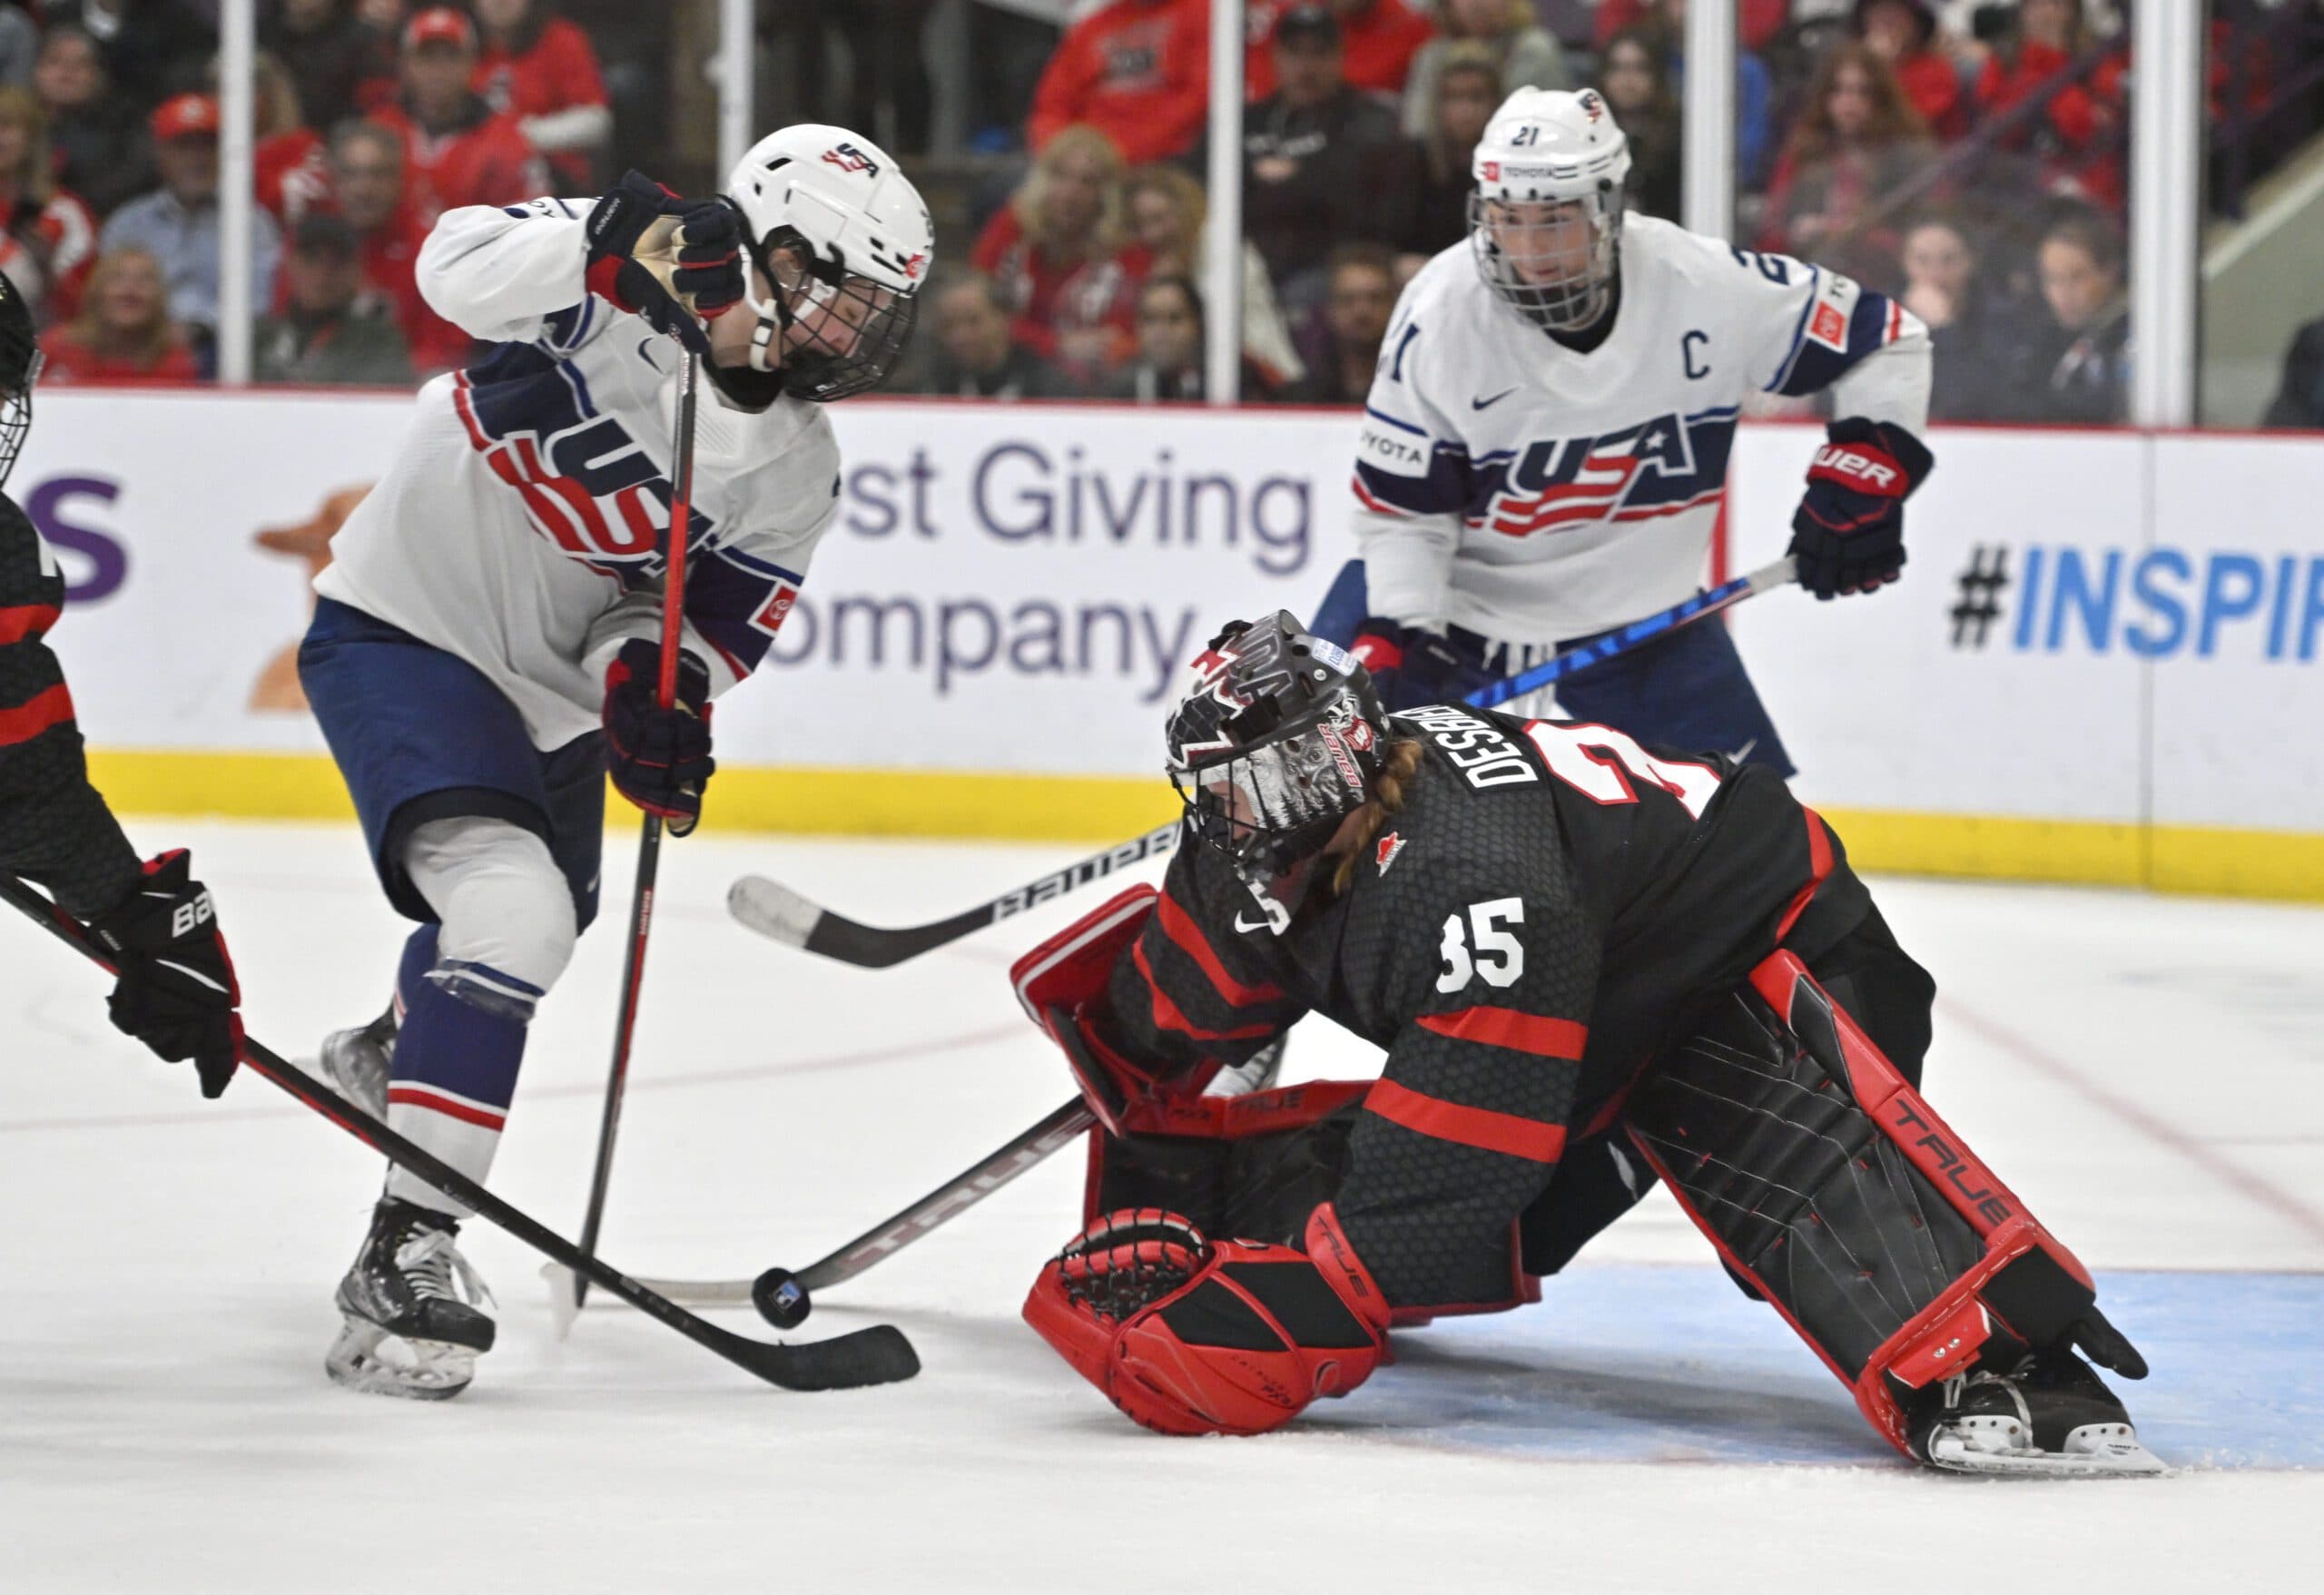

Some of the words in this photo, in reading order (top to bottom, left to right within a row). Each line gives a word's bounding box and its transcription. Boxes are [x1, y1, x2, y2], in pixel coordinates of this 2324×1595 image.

[821, 143, 880, 179] USA
[1511, 126, 1540, 146] 21
[1682, 329, 1709, 380] C
[1362, 429, 1423, 464] YOTA
[1490, 411, 1698, 537] USA
[1814, 445, 1897, 488] UER
[846, 449, 940, 538] st
[971, 442, 1311, 576] Giving
[767, 592, 1196, 706] ompany
[1315, 723, 1363, 789] BAUER
[1435, 896, 1524, 993] 35
[1896, 1098, 2013, 1227] TRUE
[1316, 1214, 1372, 1299] TRUE
